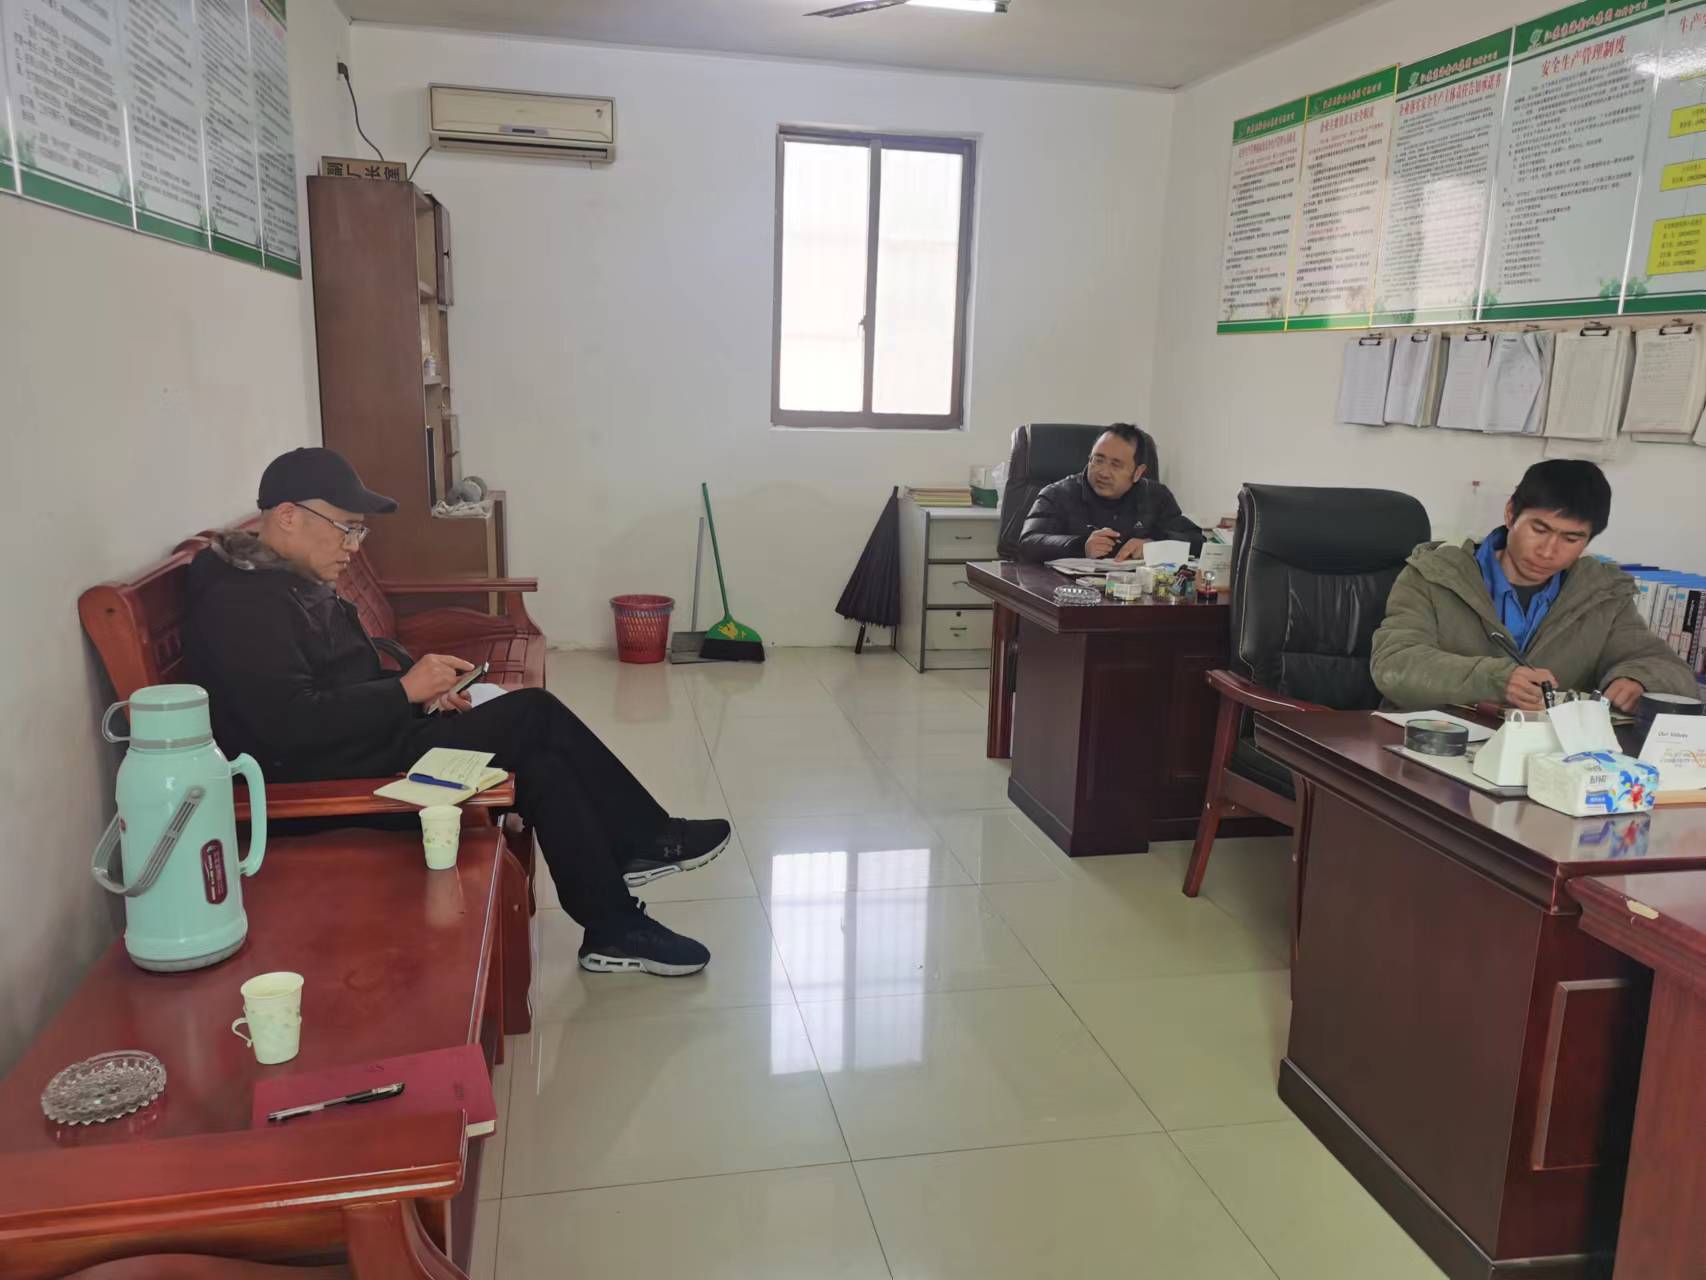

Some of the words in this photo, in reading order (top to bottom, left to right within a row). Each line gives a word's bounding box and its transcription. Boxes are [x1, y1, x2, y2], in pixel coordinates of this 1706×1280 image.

[1542, 35, 1626, 77] 安全生产管理制度
